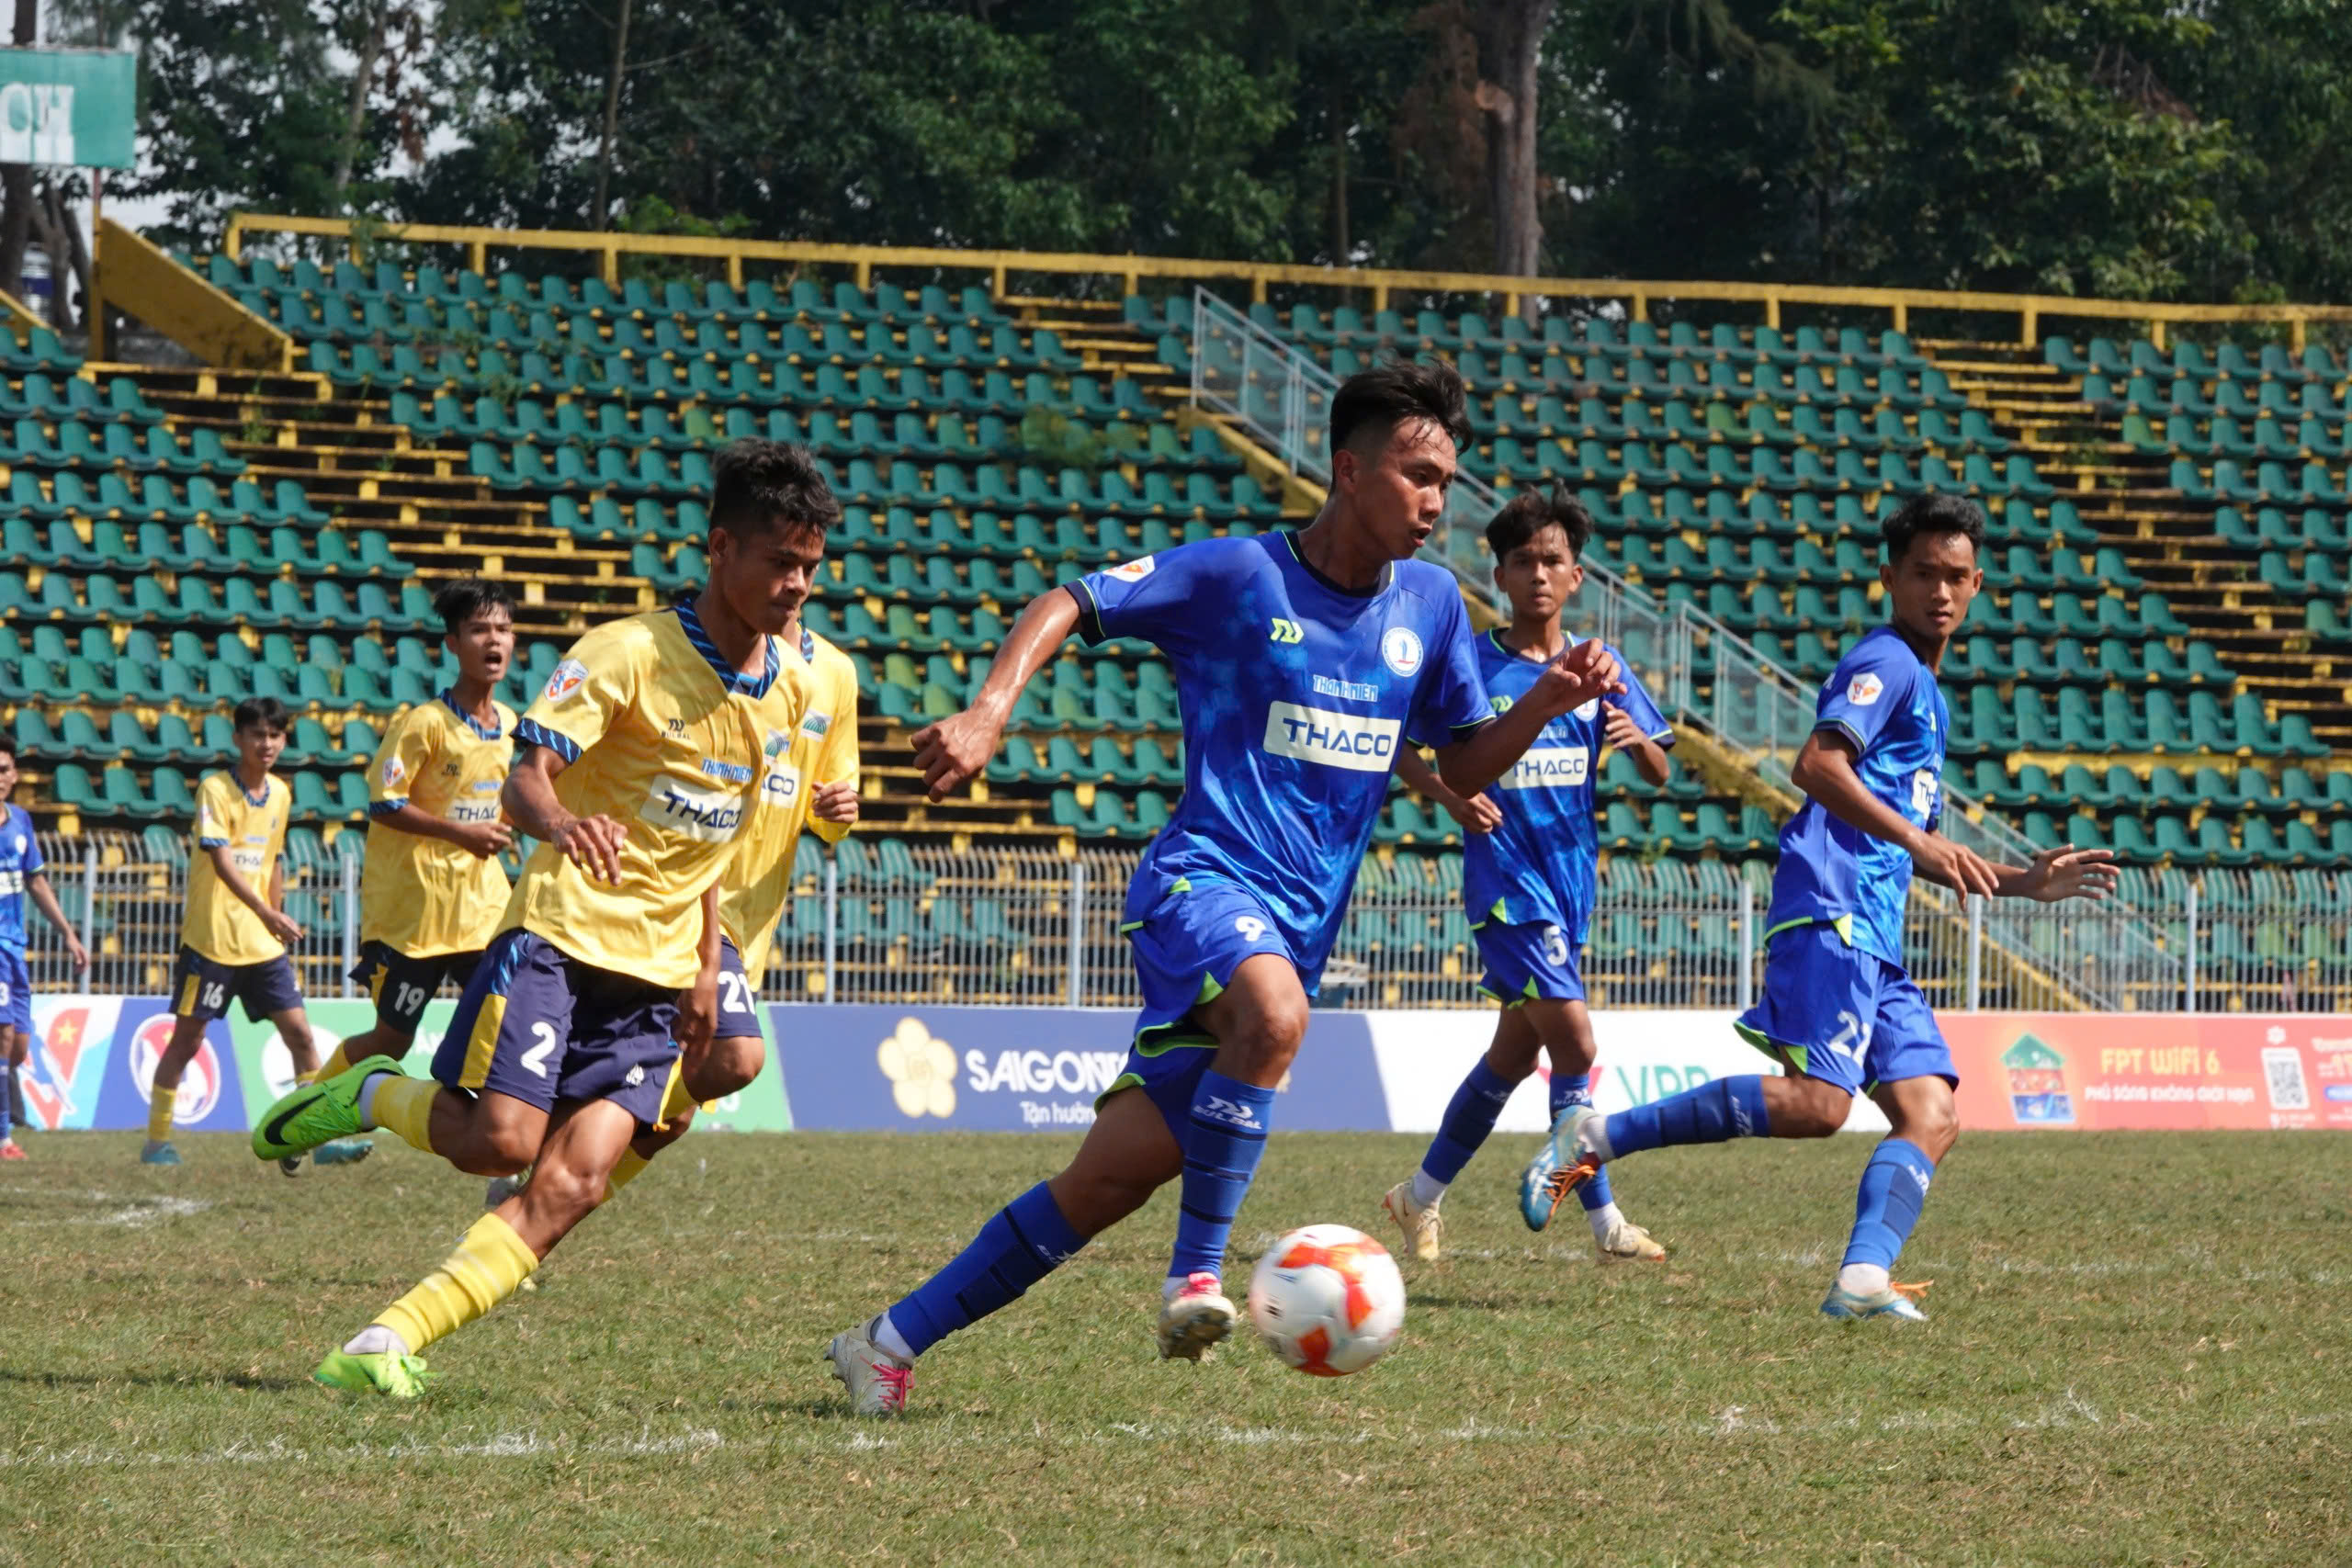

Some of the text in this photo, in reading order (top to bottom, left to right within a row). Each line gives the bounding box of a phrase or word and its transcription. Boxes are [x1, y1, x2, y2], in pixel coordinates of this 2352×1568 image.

[1283, 718, 1391, 757] THACO
[1235, 915, 1267, 942] 9
[1544, 925, 1567, 966] 5
[201, 981, 224, 1010] 16
[394, 981, 424, 1016] 19
[717, 970, 756, 1015] 21
[520, 1021, 556, 1079] 2
[2100, 1048, 2144, 1074] FPT
[2206, 1049, 2221, 1075] 6
